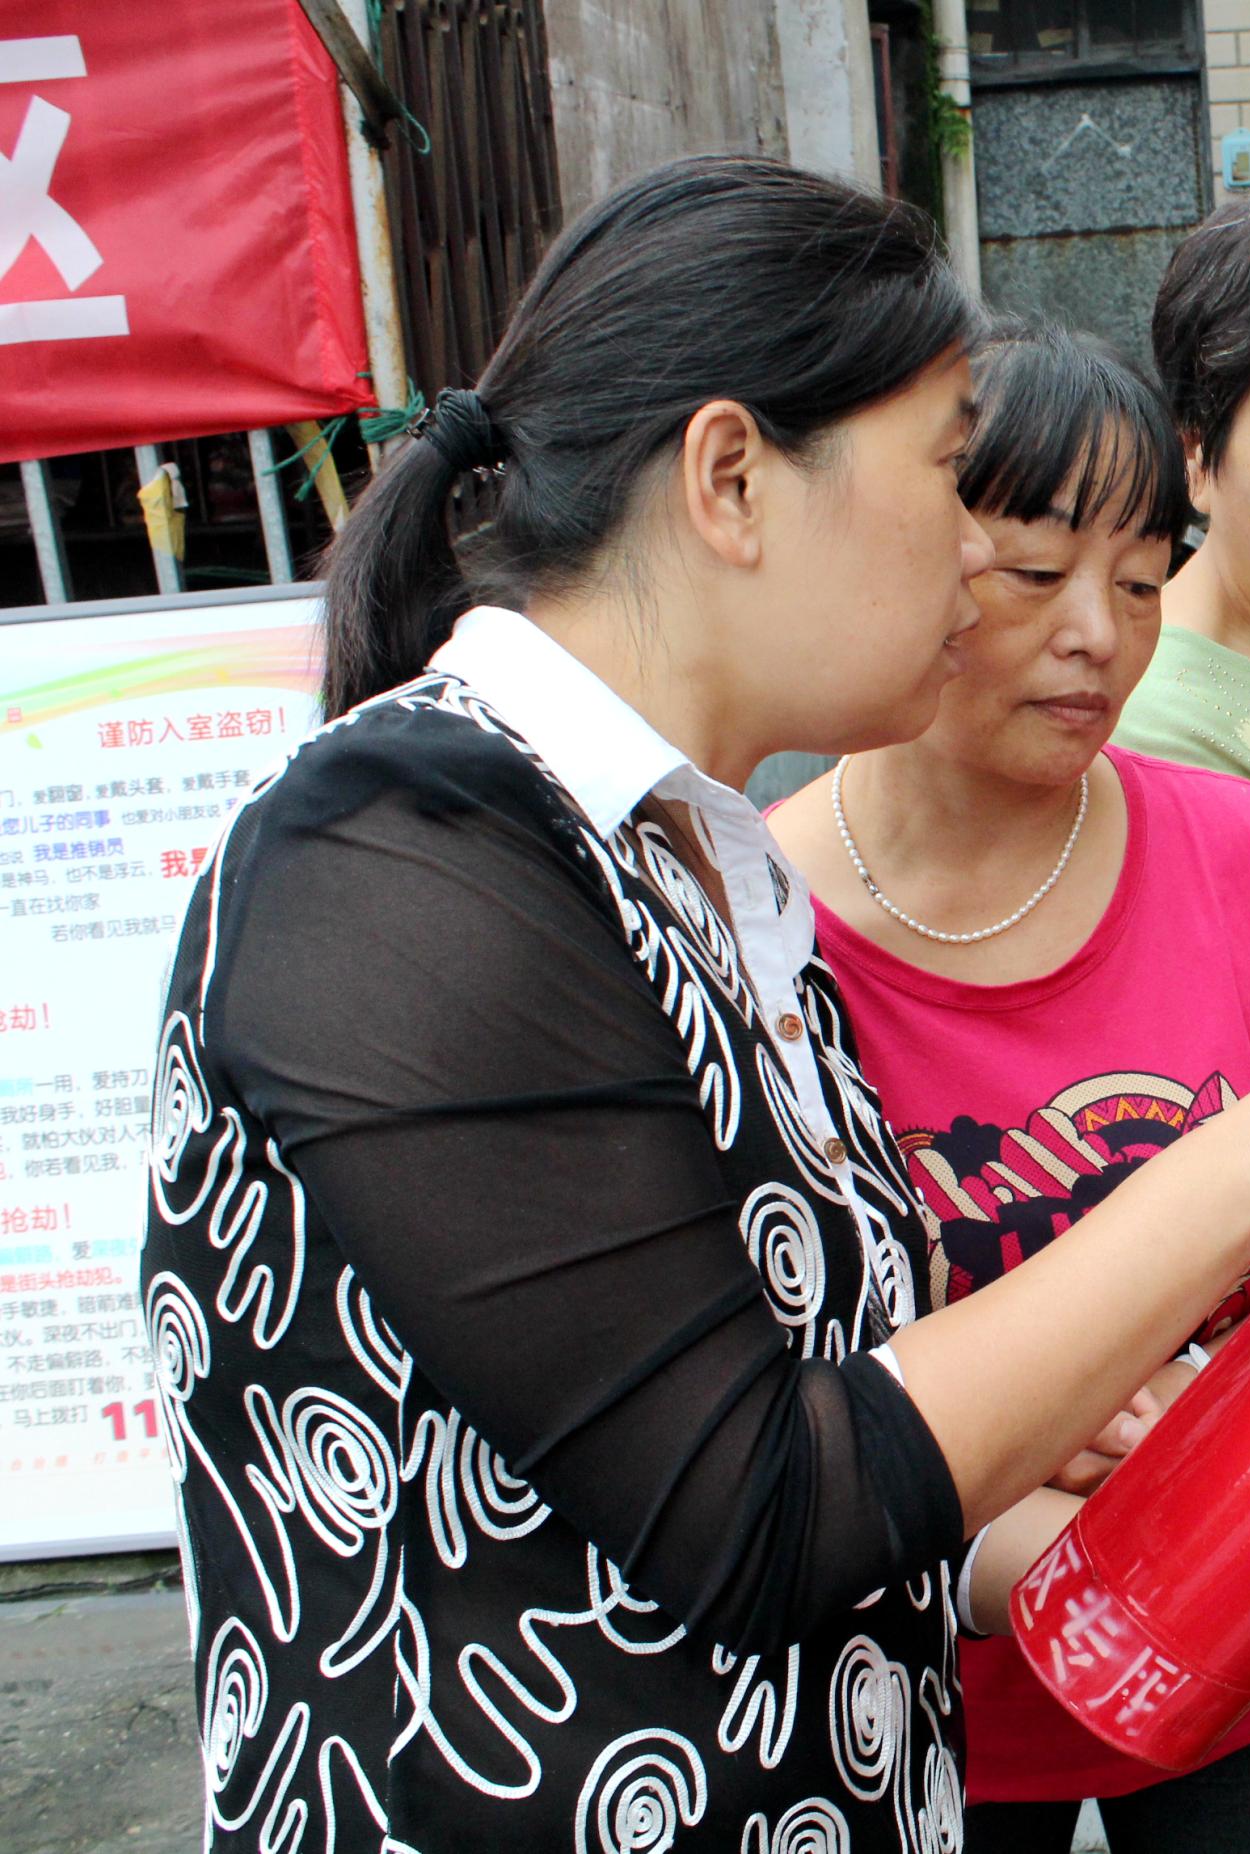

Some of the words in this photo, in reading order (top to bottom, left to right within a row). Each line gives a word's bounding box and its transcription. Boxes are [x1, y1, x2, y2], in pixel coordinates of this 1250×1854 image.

[97, 706, 287, 749] 谨防入室盗窃！
[0, 808, 111, 836] 您儿子的同事
[33, 837, 124, 863] 我是推销员
[1, 1203, 71, 1235] 抢劫！
[13, 1404, 88, 1428] 马上拨打
